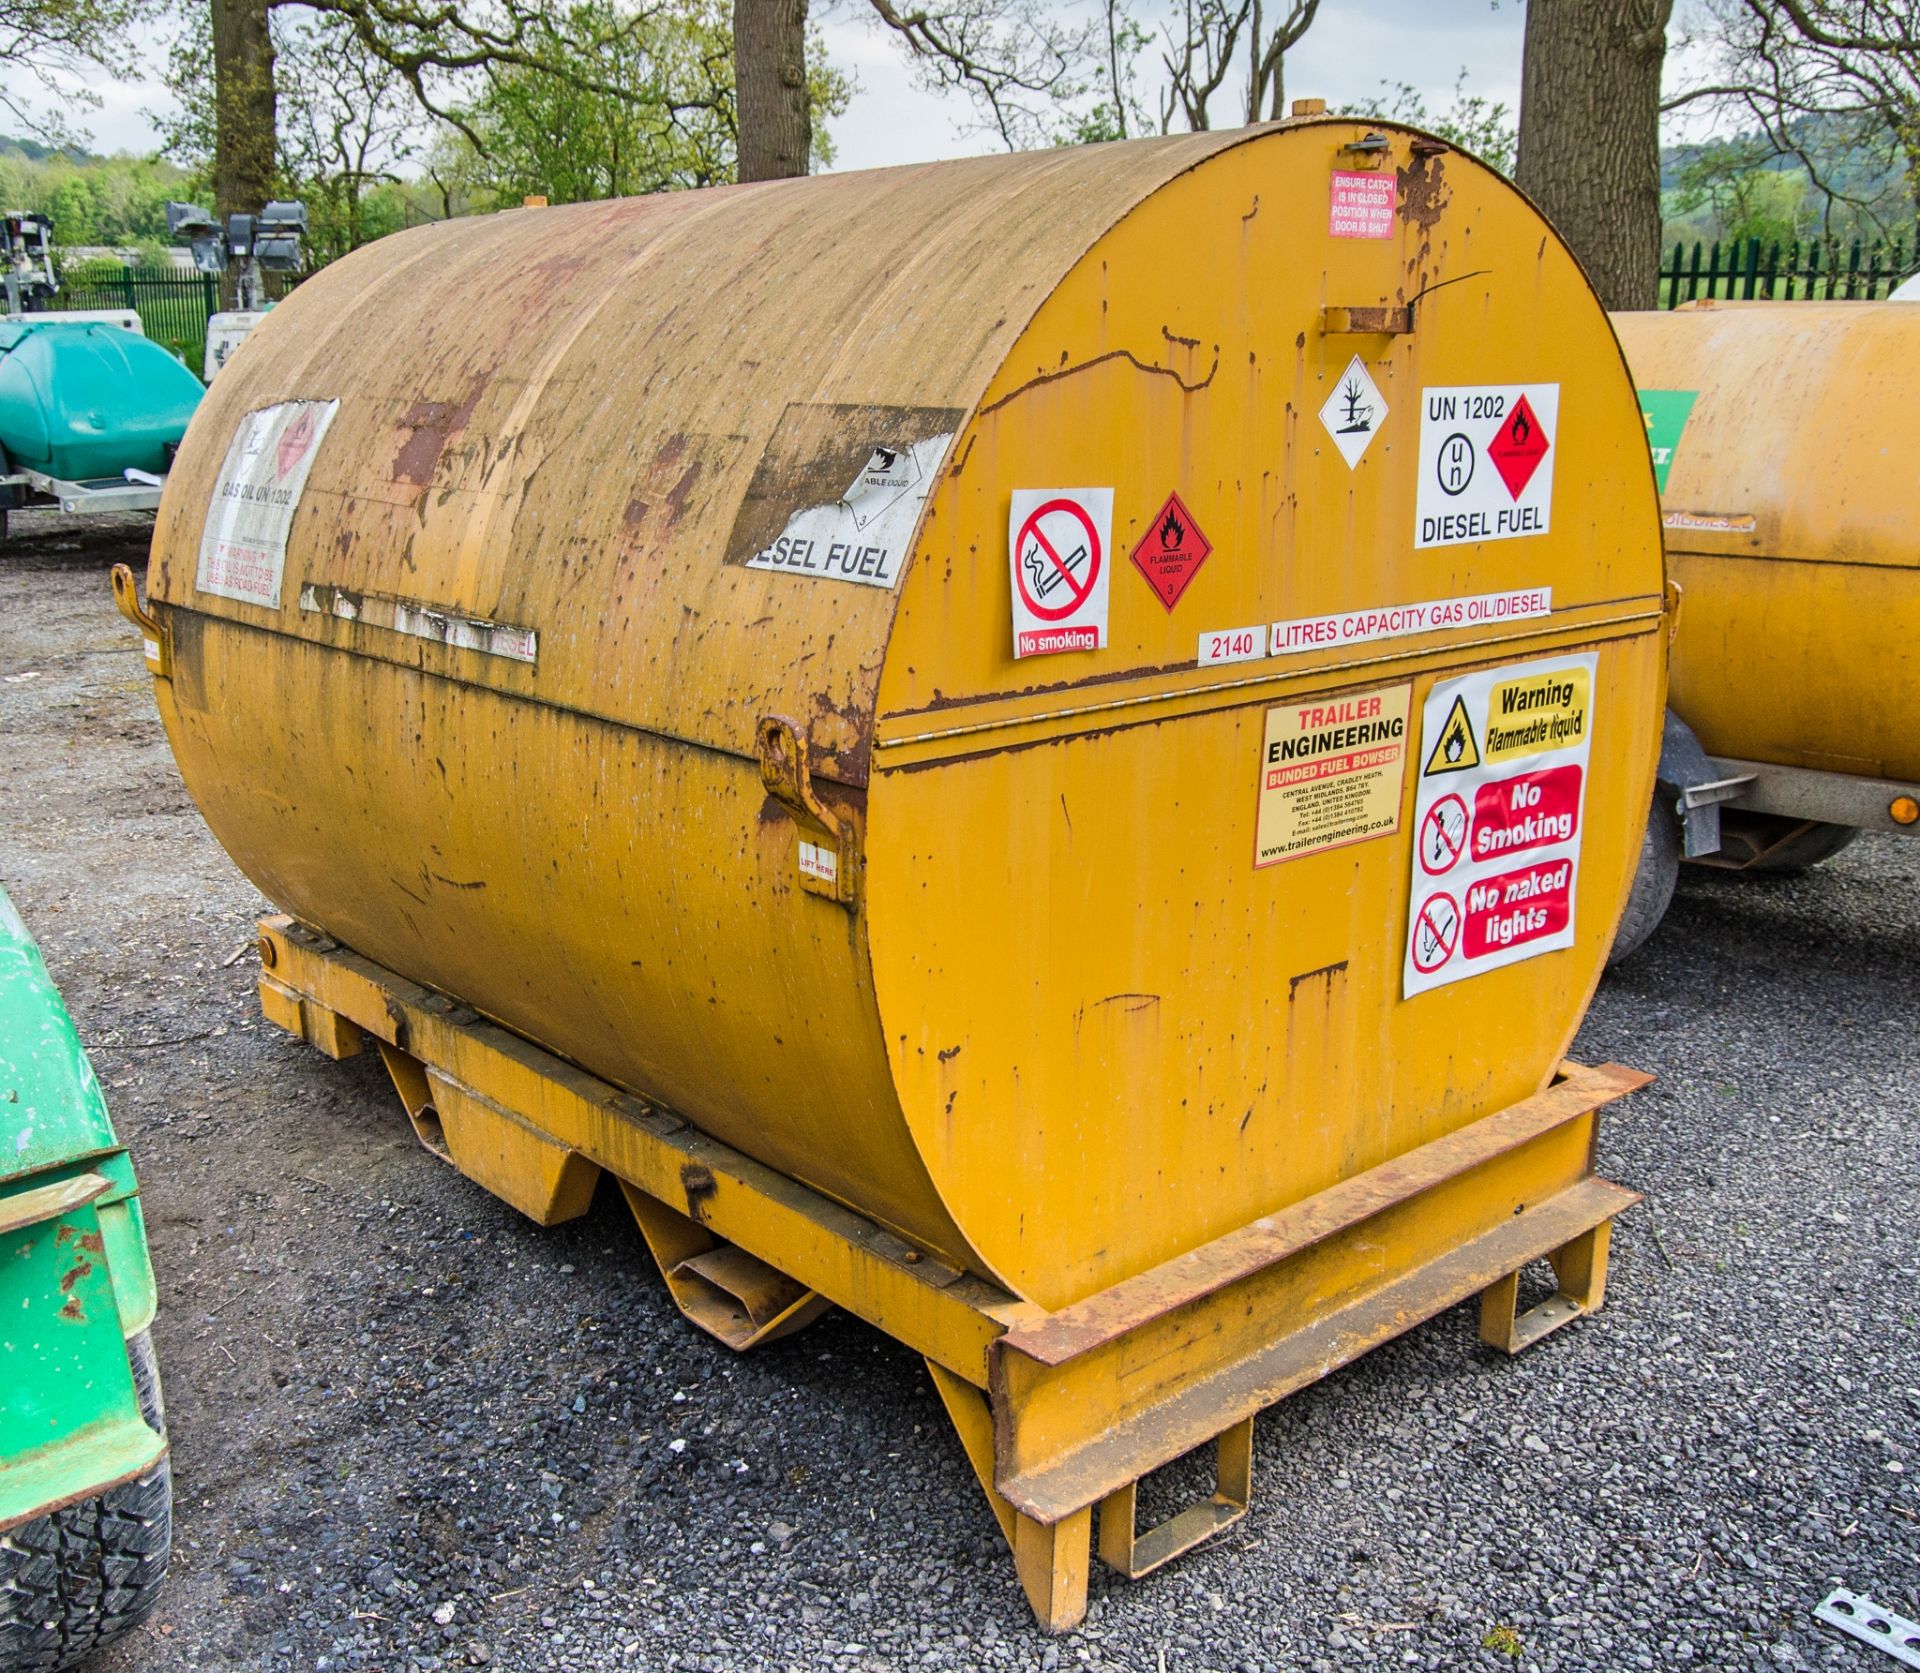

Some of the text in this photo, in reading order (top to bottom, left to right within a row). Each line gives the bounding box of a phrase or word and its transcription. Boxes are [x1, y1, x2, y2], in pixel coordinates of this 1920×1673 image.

[1335, 176, 1393, 191] ENSURE CATCH
[1338, 191, 1388, 205] IS IN CLOSED
[1331, 206, 1393, 219] POSITION WHEN
[1335, 221, 1389, 233] DOOR IS SHUT
[1429, 395, 1504, 422] UN 1202
[222, 481, 293, 505] GAS OIL UN 1202
[859, 515, 867, 527] 3
[1422, 506, 1543, 543] DIESEL FUEL
[824, 543, 889, 579] FUEL
[1150, 552, 1192, 565] FLAMMABLE
[1159, 564, 1182, 575] LIQUID
[1167, 583, 1173, 595] 3
[1211, 592, 1547, 659] 2140 LITRES CAPACITY GAS OIL/DIESEL
[1020, 631, 1095, 653] No smoking
[1501, 679, 1575, 715] Warning
[1298, 696, 1382, 731] TRAILER
[1268, 717, 1404, 763] ENGINEERING
[1486, 709, 1583, 755] Flammable liquid
[1268, 746, 1400, 786] BUNDED FUEL BOWSER
[1282, 789, 1309, 799] CENTRAL
[1336, 776, 1362, 787] CRADLEY
[1296, 793, 1312, 803] WEST
[1510, 782, 1542, 811] No
[1322, 795, 1343, 806] UNITED
[1261, 816, 1394, 857] www.trailerengineering.co.uk
[1477, 812, 1573, 855] Smoking
[800, 857, 834, 877] LIFT HERE
[1469, 863, 1569, 916] No naked
[1485, 908, 1548, 945] lights
